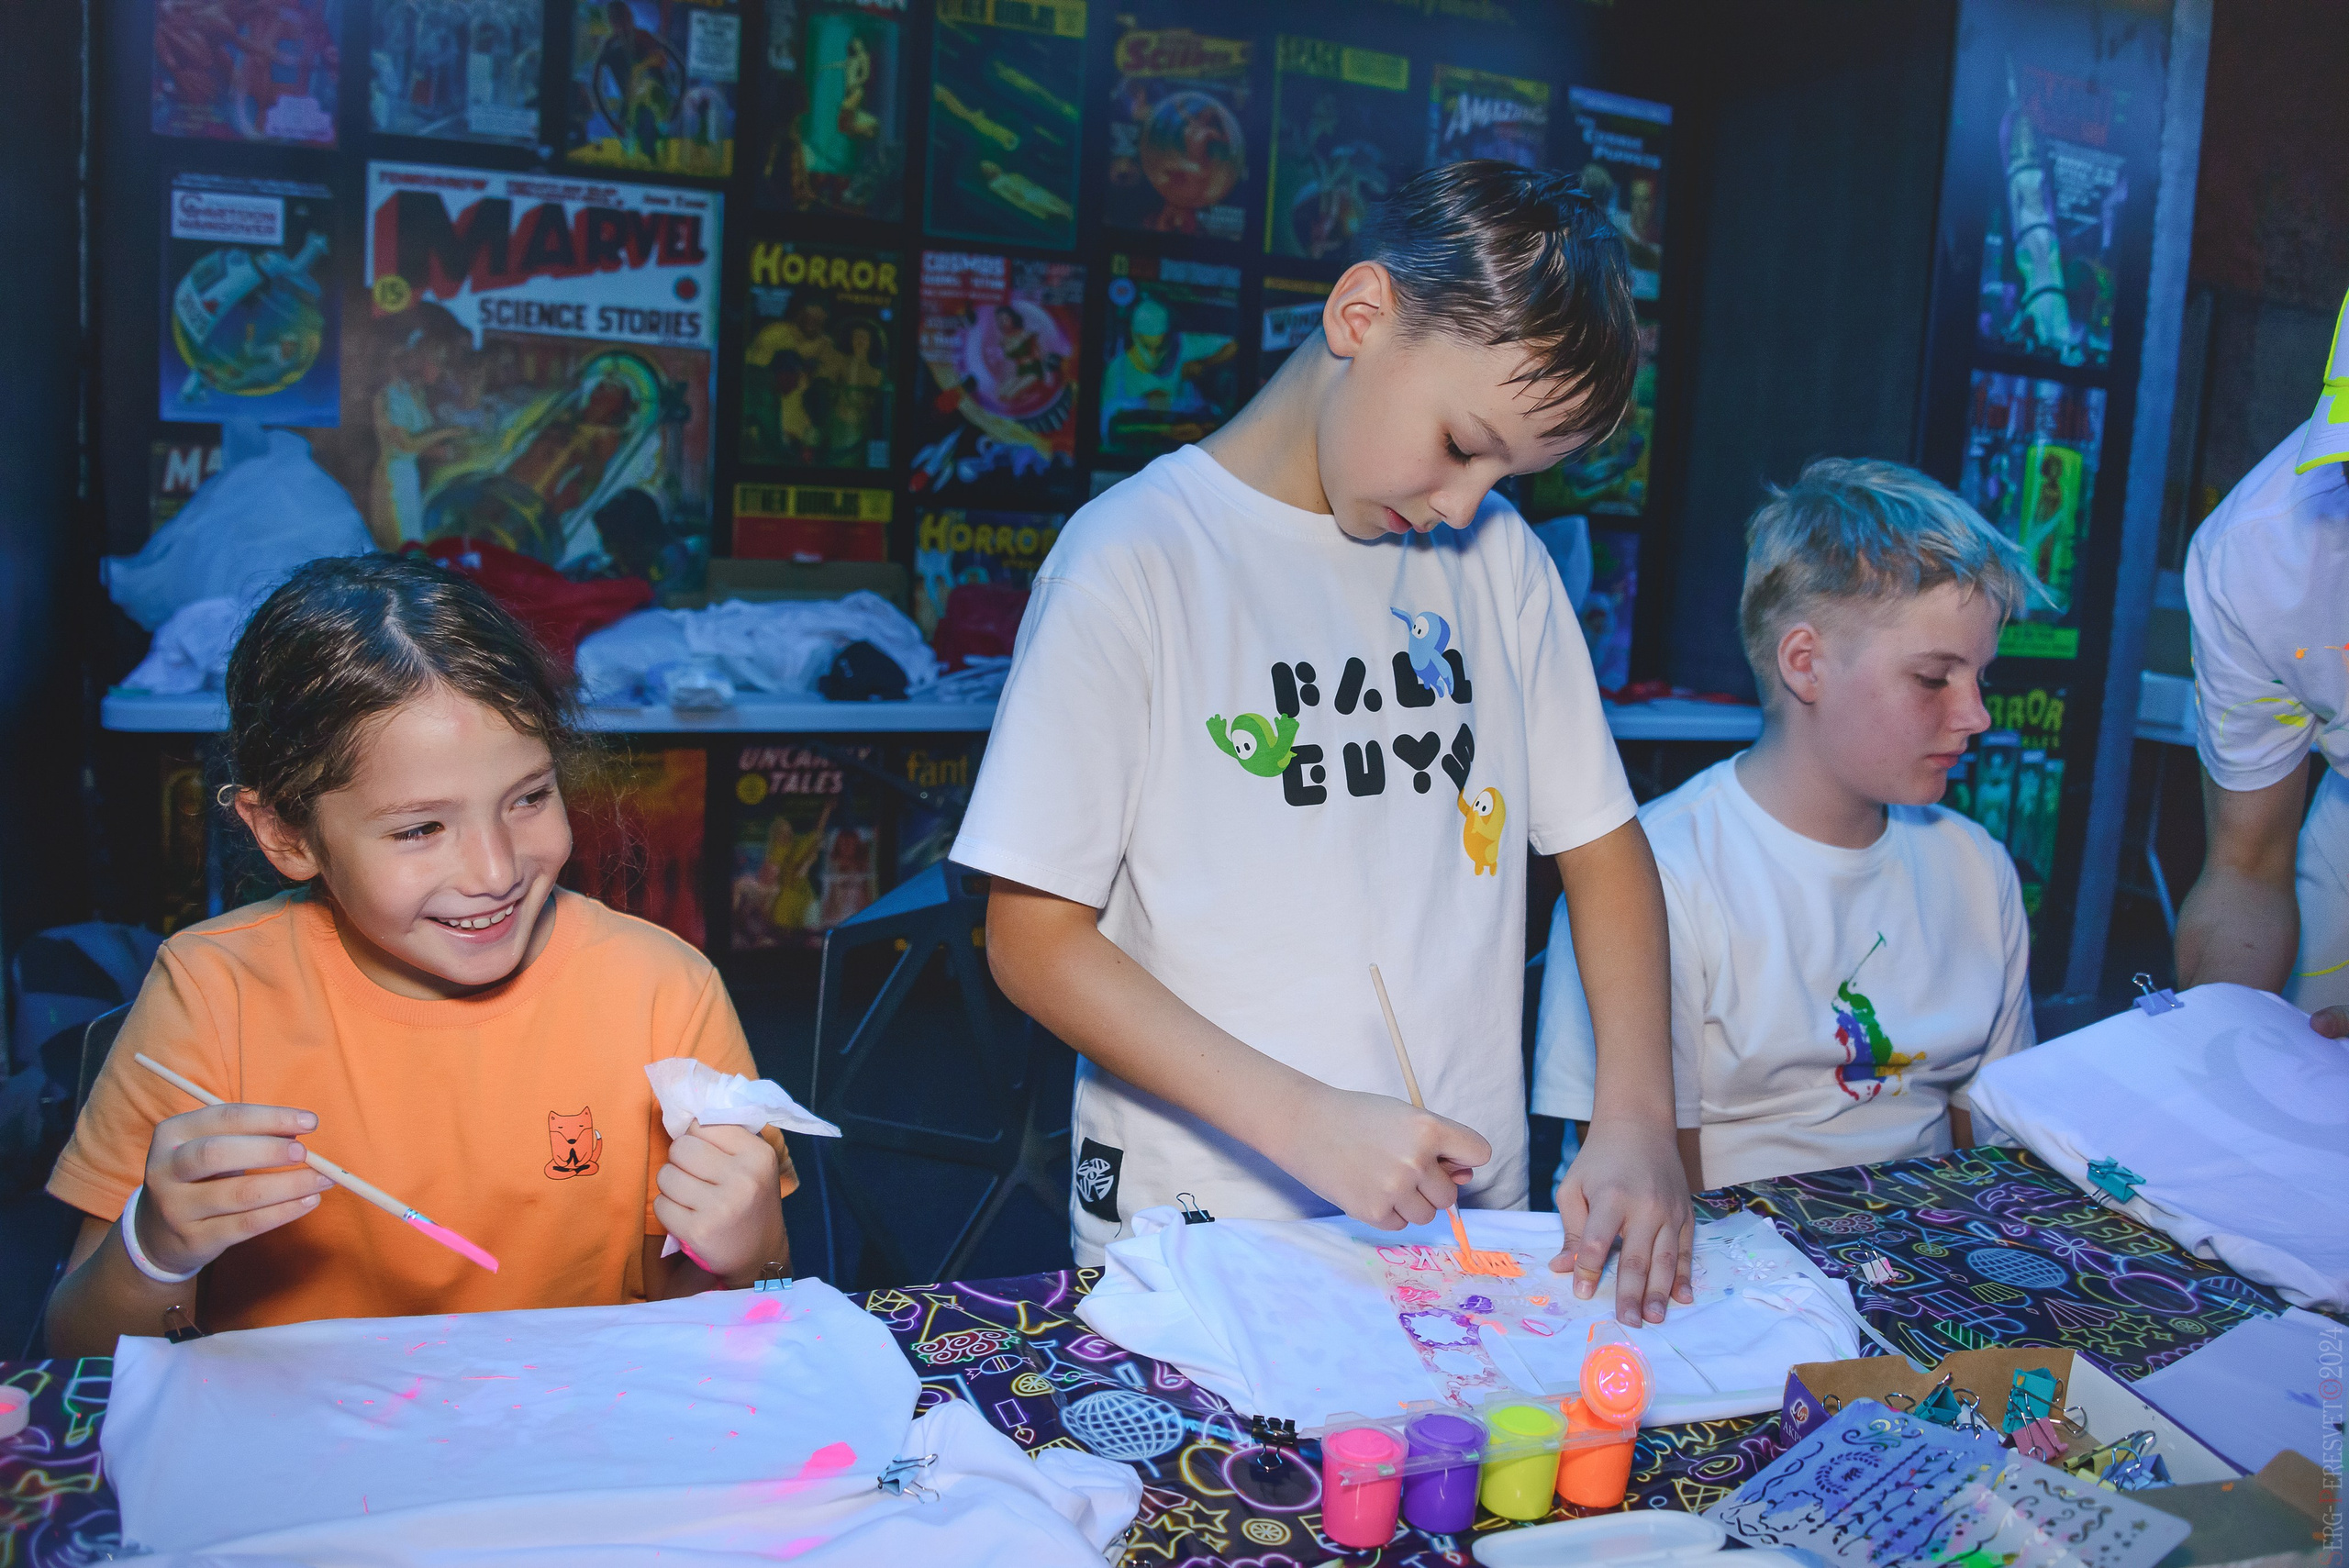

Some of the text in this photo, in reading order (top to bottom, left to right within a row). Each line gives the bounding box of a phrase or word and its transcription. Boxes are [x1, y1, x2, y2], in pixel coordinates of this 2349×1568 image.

[375, 190, 707, 301] MARVEL
[751, 241, 898, 295] HORROR
[480, 297, 702, 337] SCIENCE STORIES
[770, 771, 843, 795] TALES
